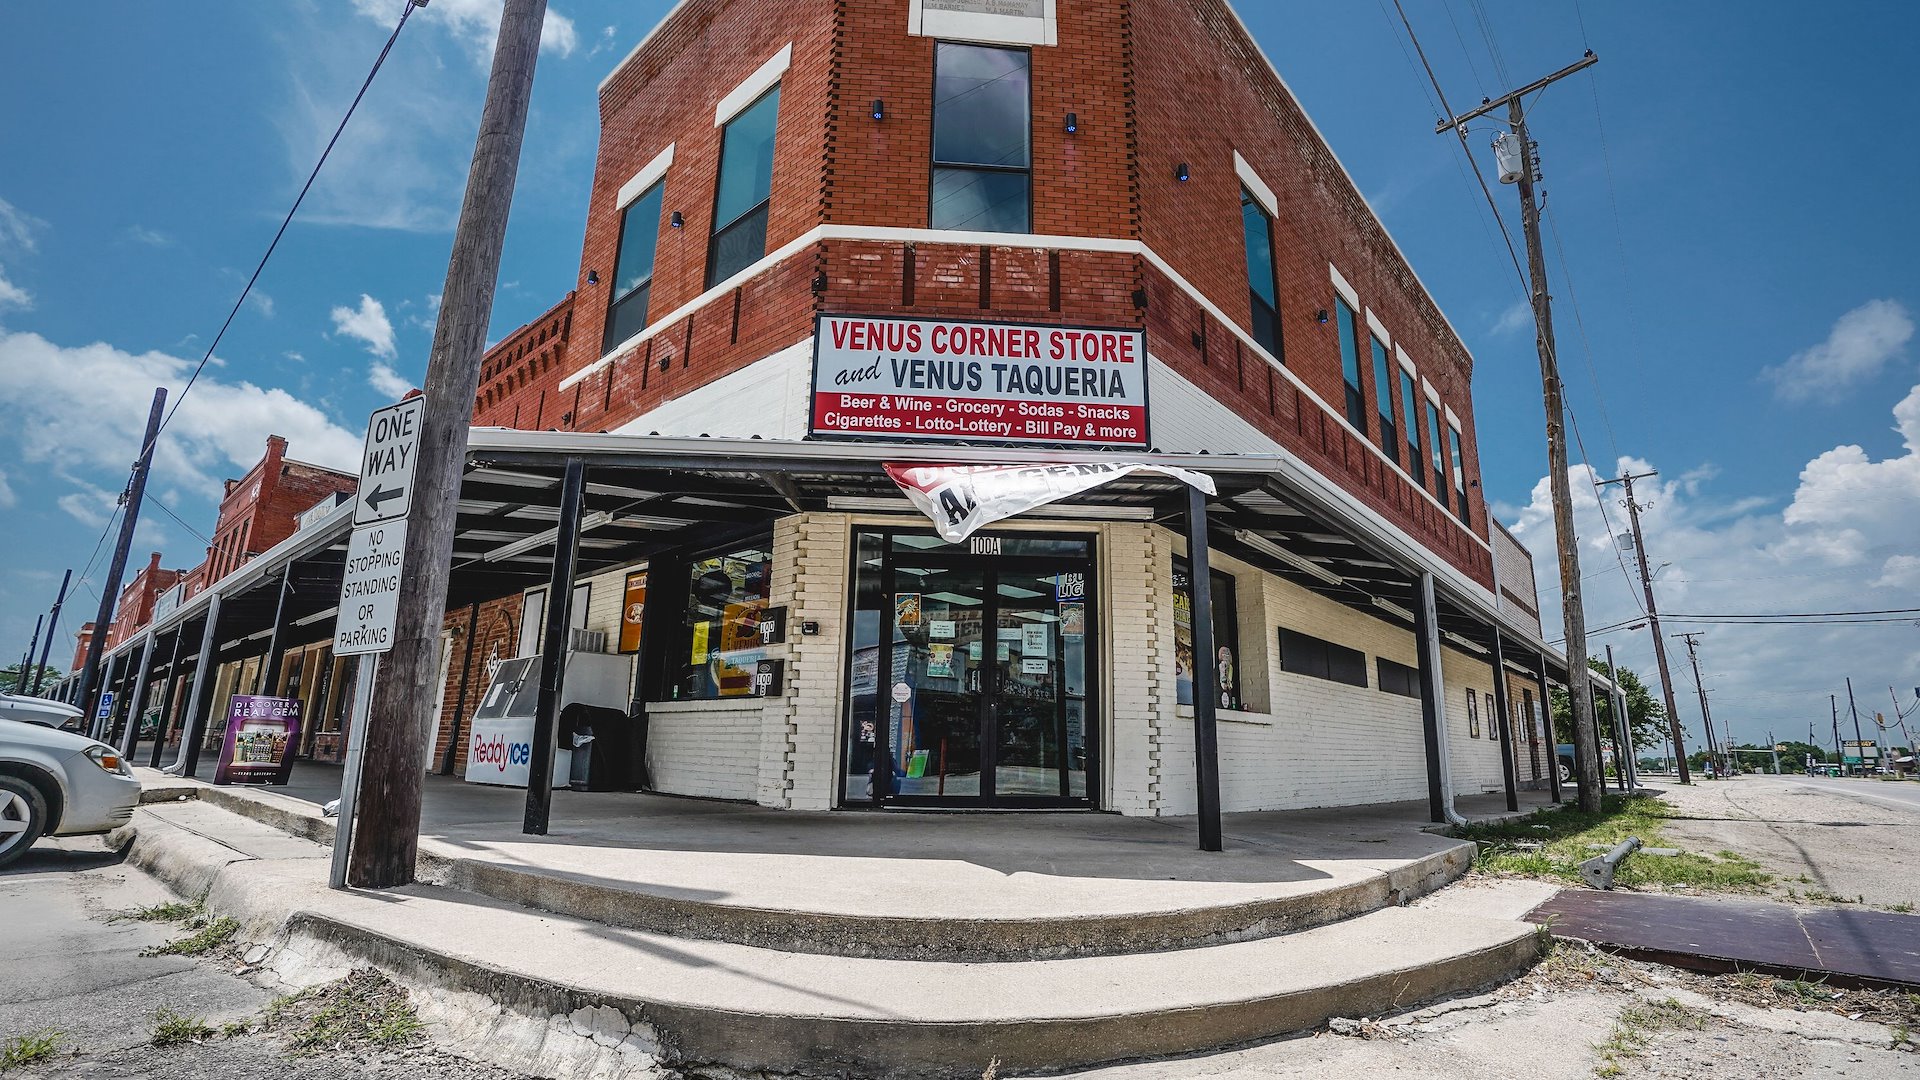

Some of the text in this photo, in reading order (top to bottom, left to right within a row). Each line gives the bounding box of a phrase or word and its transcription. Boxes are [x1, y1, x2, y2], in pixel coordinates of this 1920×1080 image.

[831, 320, 1135, 363] VENUS CORNER STORE
[834, 355, 1126, 398] and VENUS TAQUERIA
[840, 395, 876, 410] Beer
[879, 396, 890, 410] &
[895, 396, 933, 412] Wine
[945, 399, 1006, 418] Grocery
[1018, 402, 1065, 418] Sodas
[1077, 405, 1130, 420] Snacks
[375, 409, 415, 443] ONE
[824, 412, 901, 430] Cigarettes
[915, 415, 1012, 436] Lotto-Lottery
[1025, 420, 1049, 434] Bill
[1053, 421, 1080, 438] Pay
[1084, 423, 1095, 437] &
[1099, 427, 1137, 438] more
[368, 441, 413, 477] WAY
[368, 530, 384, 547] NO
[972, 537, 999, 554] 100A
[348, 550, 400, 575] STOPPING
[344, 575, 397, 599] STANDING
[1065, 573, 1083, 583] BU
[358, 604, 374, 621] OR
[340, 627, 387, 648] PARKING
[761, 622, 774, 632] 100
[758, 675, 771, 684] 100
[234, 708, 299, 717] REAL GEM
